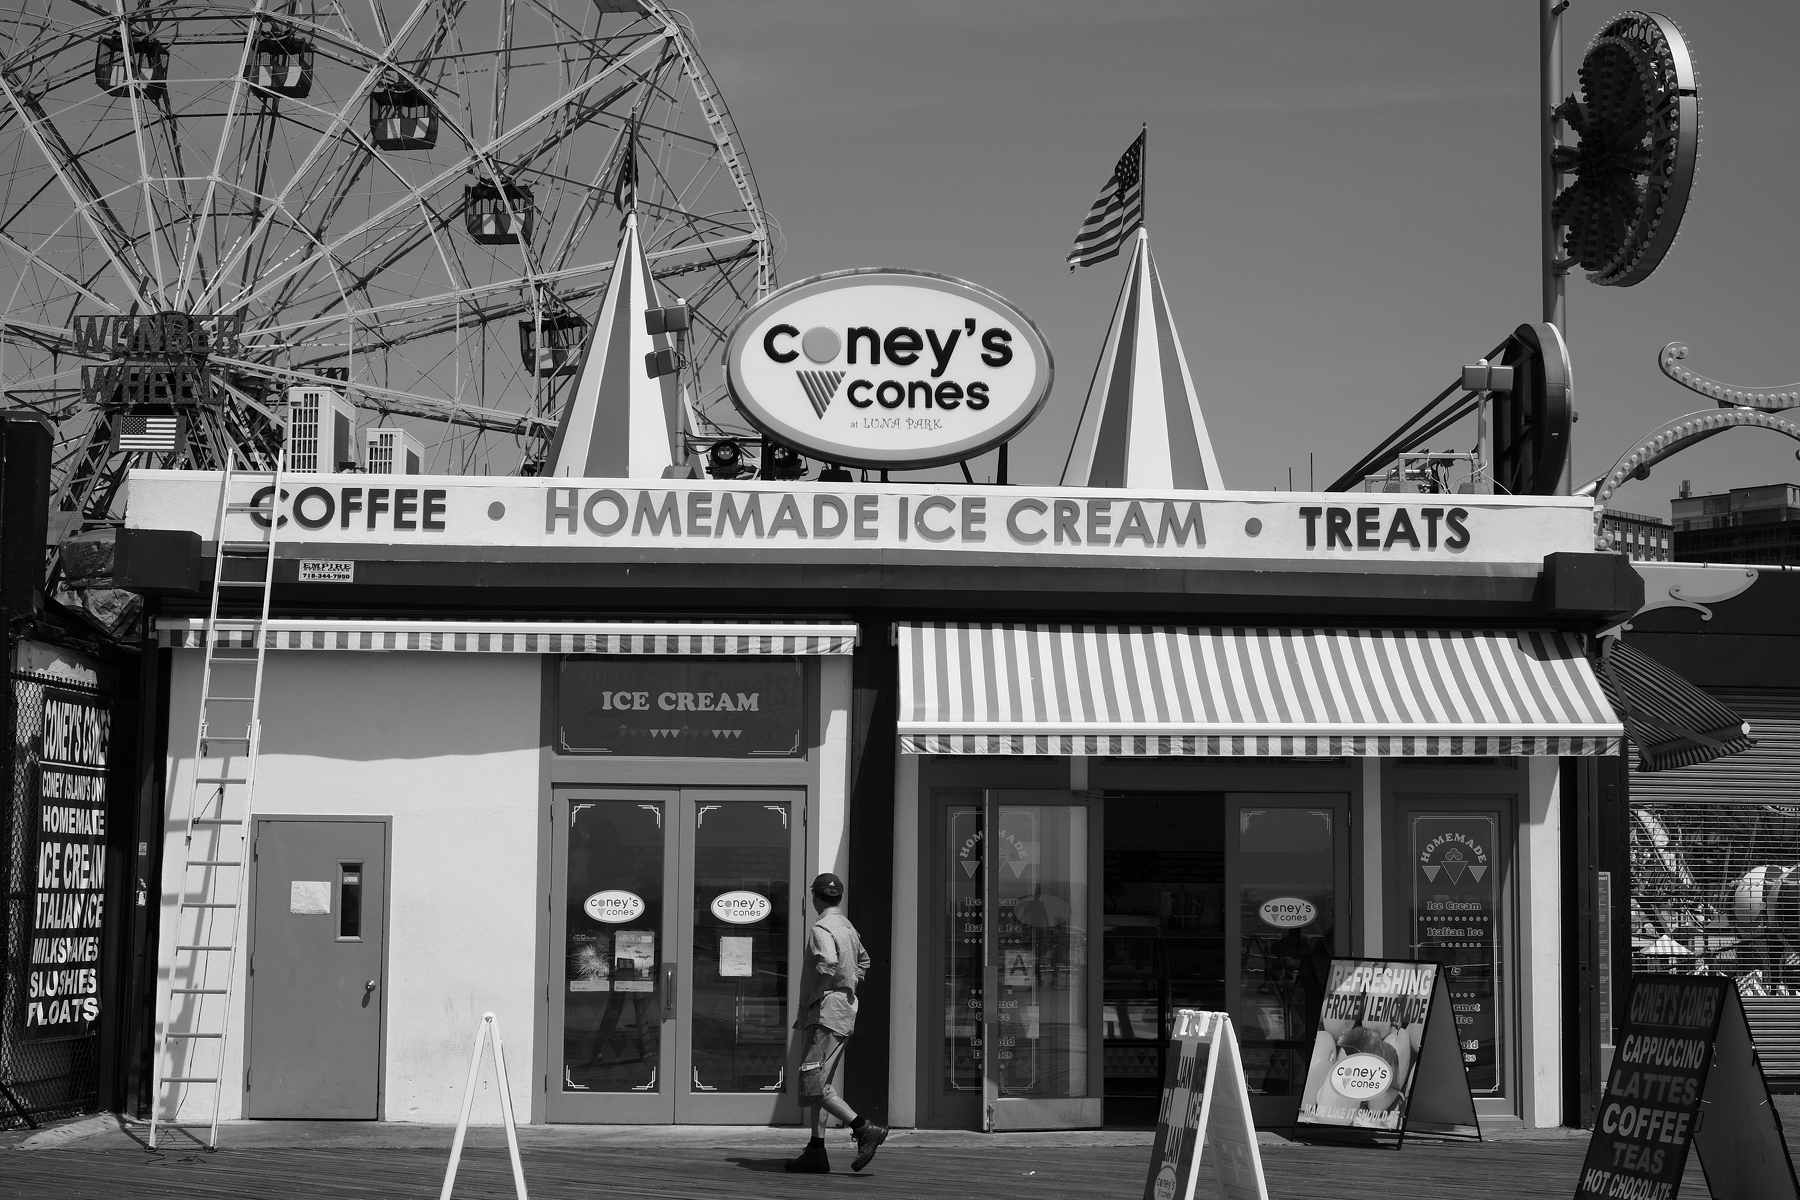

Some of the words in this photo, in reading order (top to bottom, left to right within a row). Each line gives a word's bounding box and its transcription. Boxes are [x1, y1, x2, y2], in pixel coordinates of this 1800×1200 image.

[74, 315, 240, 354] WONDER
[763, 317, 1013, 378] coney's
[81, 365, 226, 404] WHEEL
[847, 379, 991, 410] cones
[850, 421, 859, 430] at
[863, 417, 902, 430] LUNA
[905, 417, 943, 431] PARK
[249, 486, 446, 530] COFFEE
[545, 488, 880, 540] HOMEMADE
[899, 495, 987, 543] ICE
[1006, 498, 1207, 545] CREAM
[1299, 507, 1472, 553] TREATS
[601, 691, 650, 711] ICE
[657, 691, 760, 712] CREAM
[43, 699, 82, 764] CONEY'S
[42, 771, 65, 799] CONEY
[43, 805, 105, 836] HOMEMADE
[960, 829, 1028, 859] HOMMADE
[1420, 832, 1488, 864] HOMEMADE
[38, 841, 61, 889] ICE
[63, 842, 106, 890] CREAM
[35, 892, 86, 929] ITALIAN
[83, 892, 105, 928] ICE
[606, 909, 634, 917] cones
[733, 909, 761, 917] cones
[965, 897, 982, 907] Ice
[1280, 914, 1308, 922] cones
[1427, 900, 1444, 911] Ice
[1446, 900, 1482, 911] Cream
[1006, 923, 1023, 933] Ice
[1426, 927, 1465, 937] Italian
[1467, 927, 1484, 937] Ice
[32, 936, 99, 965] MILKSHAKES
[1009, 954, 1029, 976] A
[29, 967, 97, 999] SLUSHIES
[1329, 964, 1432, 996] REFRESHING
[26, 997, 100, 1028] FLOATS
[1324, 993, 1369, 1021] FROZEN
[1367, 995, 1428, 1025] LEMONADE
[1630, 982, 1681, 1025] CONEY'S
[1678, 984, 1720, 1028] CONES
[1622, 1034, 1706, 1069] CAPPUCCINO
[1350, 1079, 1381, 1090] cones
[1610, 1069, 1698, 1106] LATTES
[1303, 1103, 1328, 1117] MADE
[1328, 1106, 1345, 1120] LIKE
[1345, 1108, 1357, 1120] IT
[1356, 1109, 1388, 1122] SHOULD
[1602, 1102, 1691, 1145] COFFEE
[1612, 1141, 1666, 1175] TEAS
[1582, 1168, 1612, 1195] HOT
[1608, 1173, 1673, 1200] CHOCOLATE
